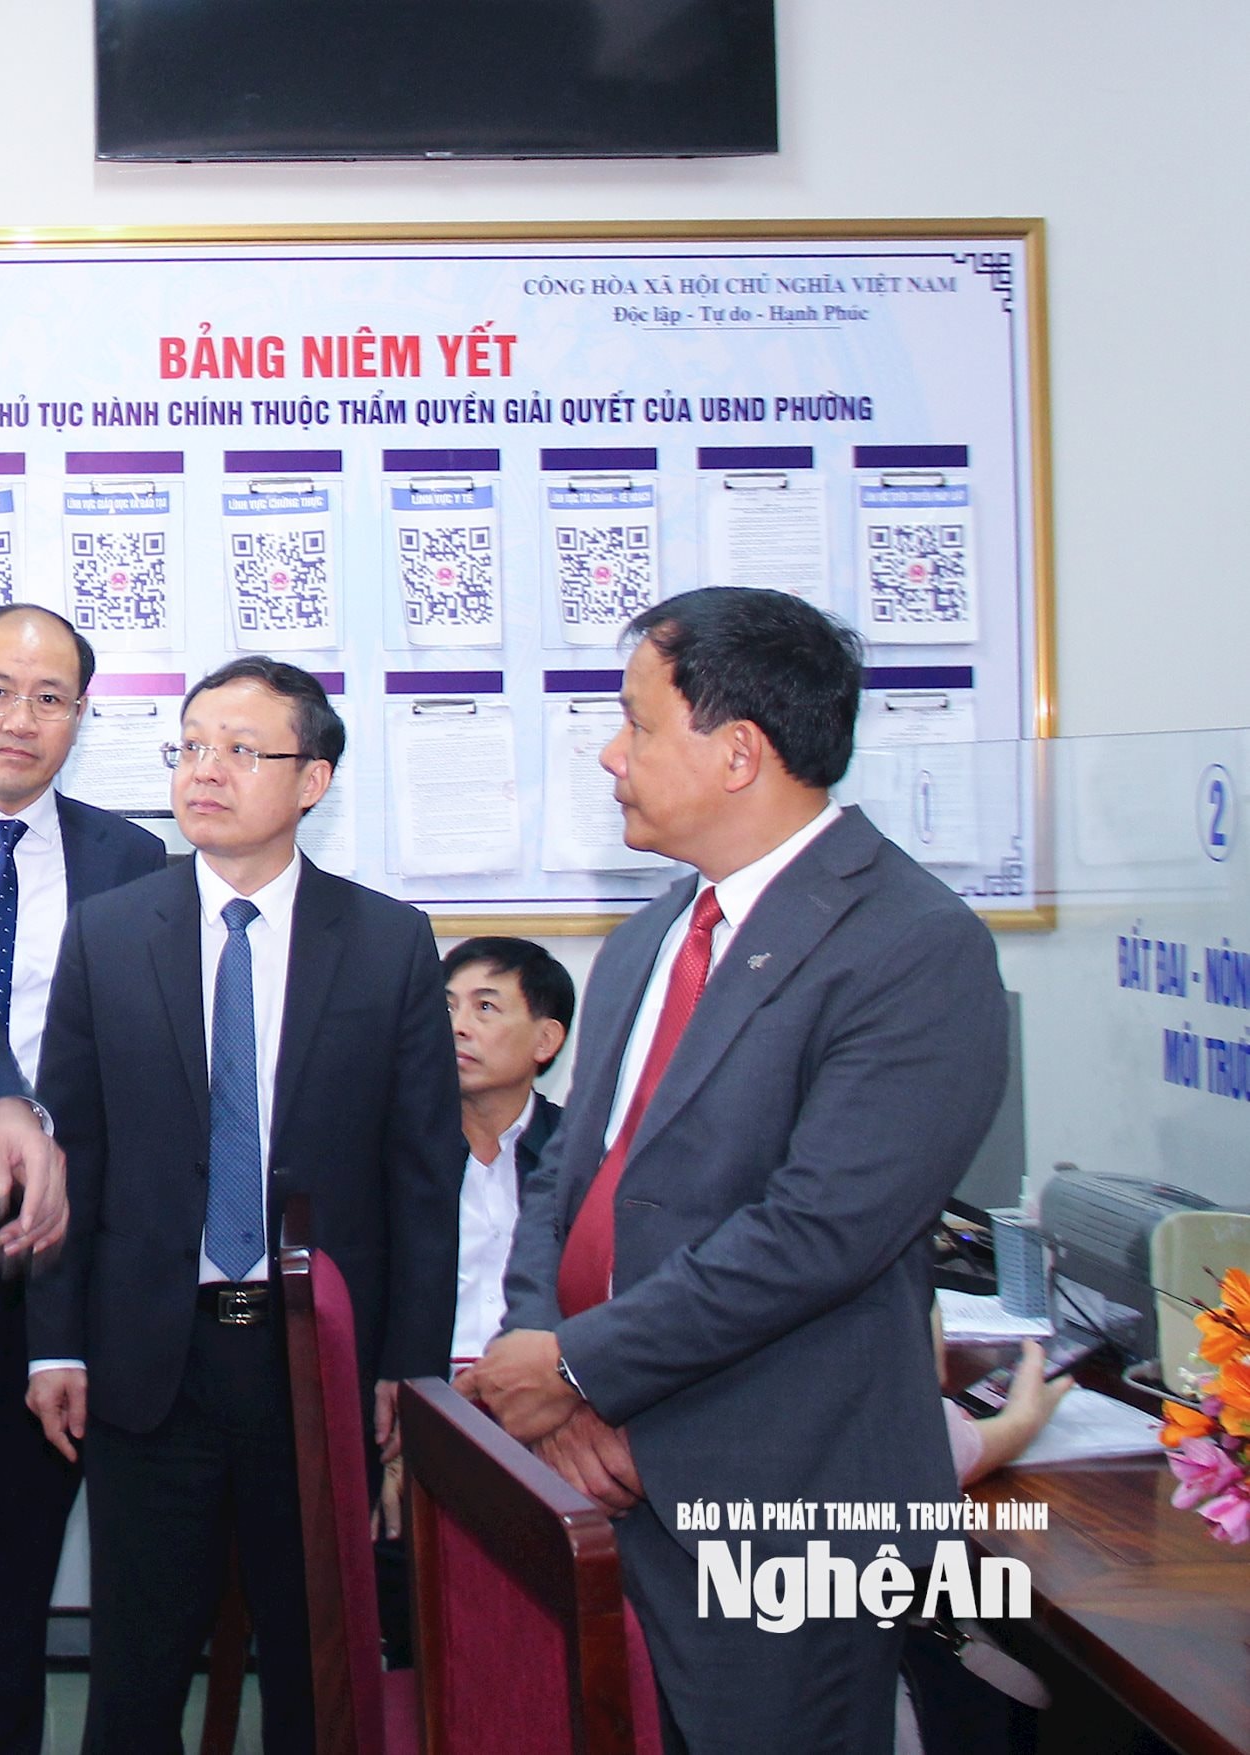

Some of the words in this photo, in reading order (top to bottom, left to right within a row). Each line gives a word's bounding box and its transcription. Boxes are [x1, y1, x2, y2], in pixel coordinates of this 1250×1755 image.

[589, 275, 639, 295] HÒA
[643, 274, 674, 295] XÃ
[677, 274, 720, 298] HỘI
[724, 273, 771, 295] CHỦ
[775, 274, 847, 294] NGHĨA
[851, 273, 903, 297] VIỆT
[906, 276, 957, 293] NAM
[613, 305, 649, 326] Độc
[653, 305, 683, 326] lập
[698, 305, 726, 326] Tự
[729, 305, 753, 323] do
[768, 305, 819, 325] Hạnh
[823, 304, 870, 322] Phúc
[159, 321, 285, 379] BẢNG
[302, 326, 421, 378] NIÊM
[436, 321, 518, 378] YẾT
[37, 402, 84, 432] TỤC
[92, 396, 159, 427] HÀNH
[167, 395, 243, 427] CHÍNH
[250, 394, 330, 430] THUỘC
[338, 390, 407, 425] THẨM
[416, 391, 495, 427] QUYỀN
[504, 391, 552, 424] GIẢI
[561, 390, 636, 426] QUYẾT
[644, 389, 693, 424] CỦA
[700, 397, 767, 423] UBND
[774, 390, 873, 422] PHƯỜNG
[1209, 780, 1226, 846] 2
[1163, 1020, 1199, 1090] MÔI
